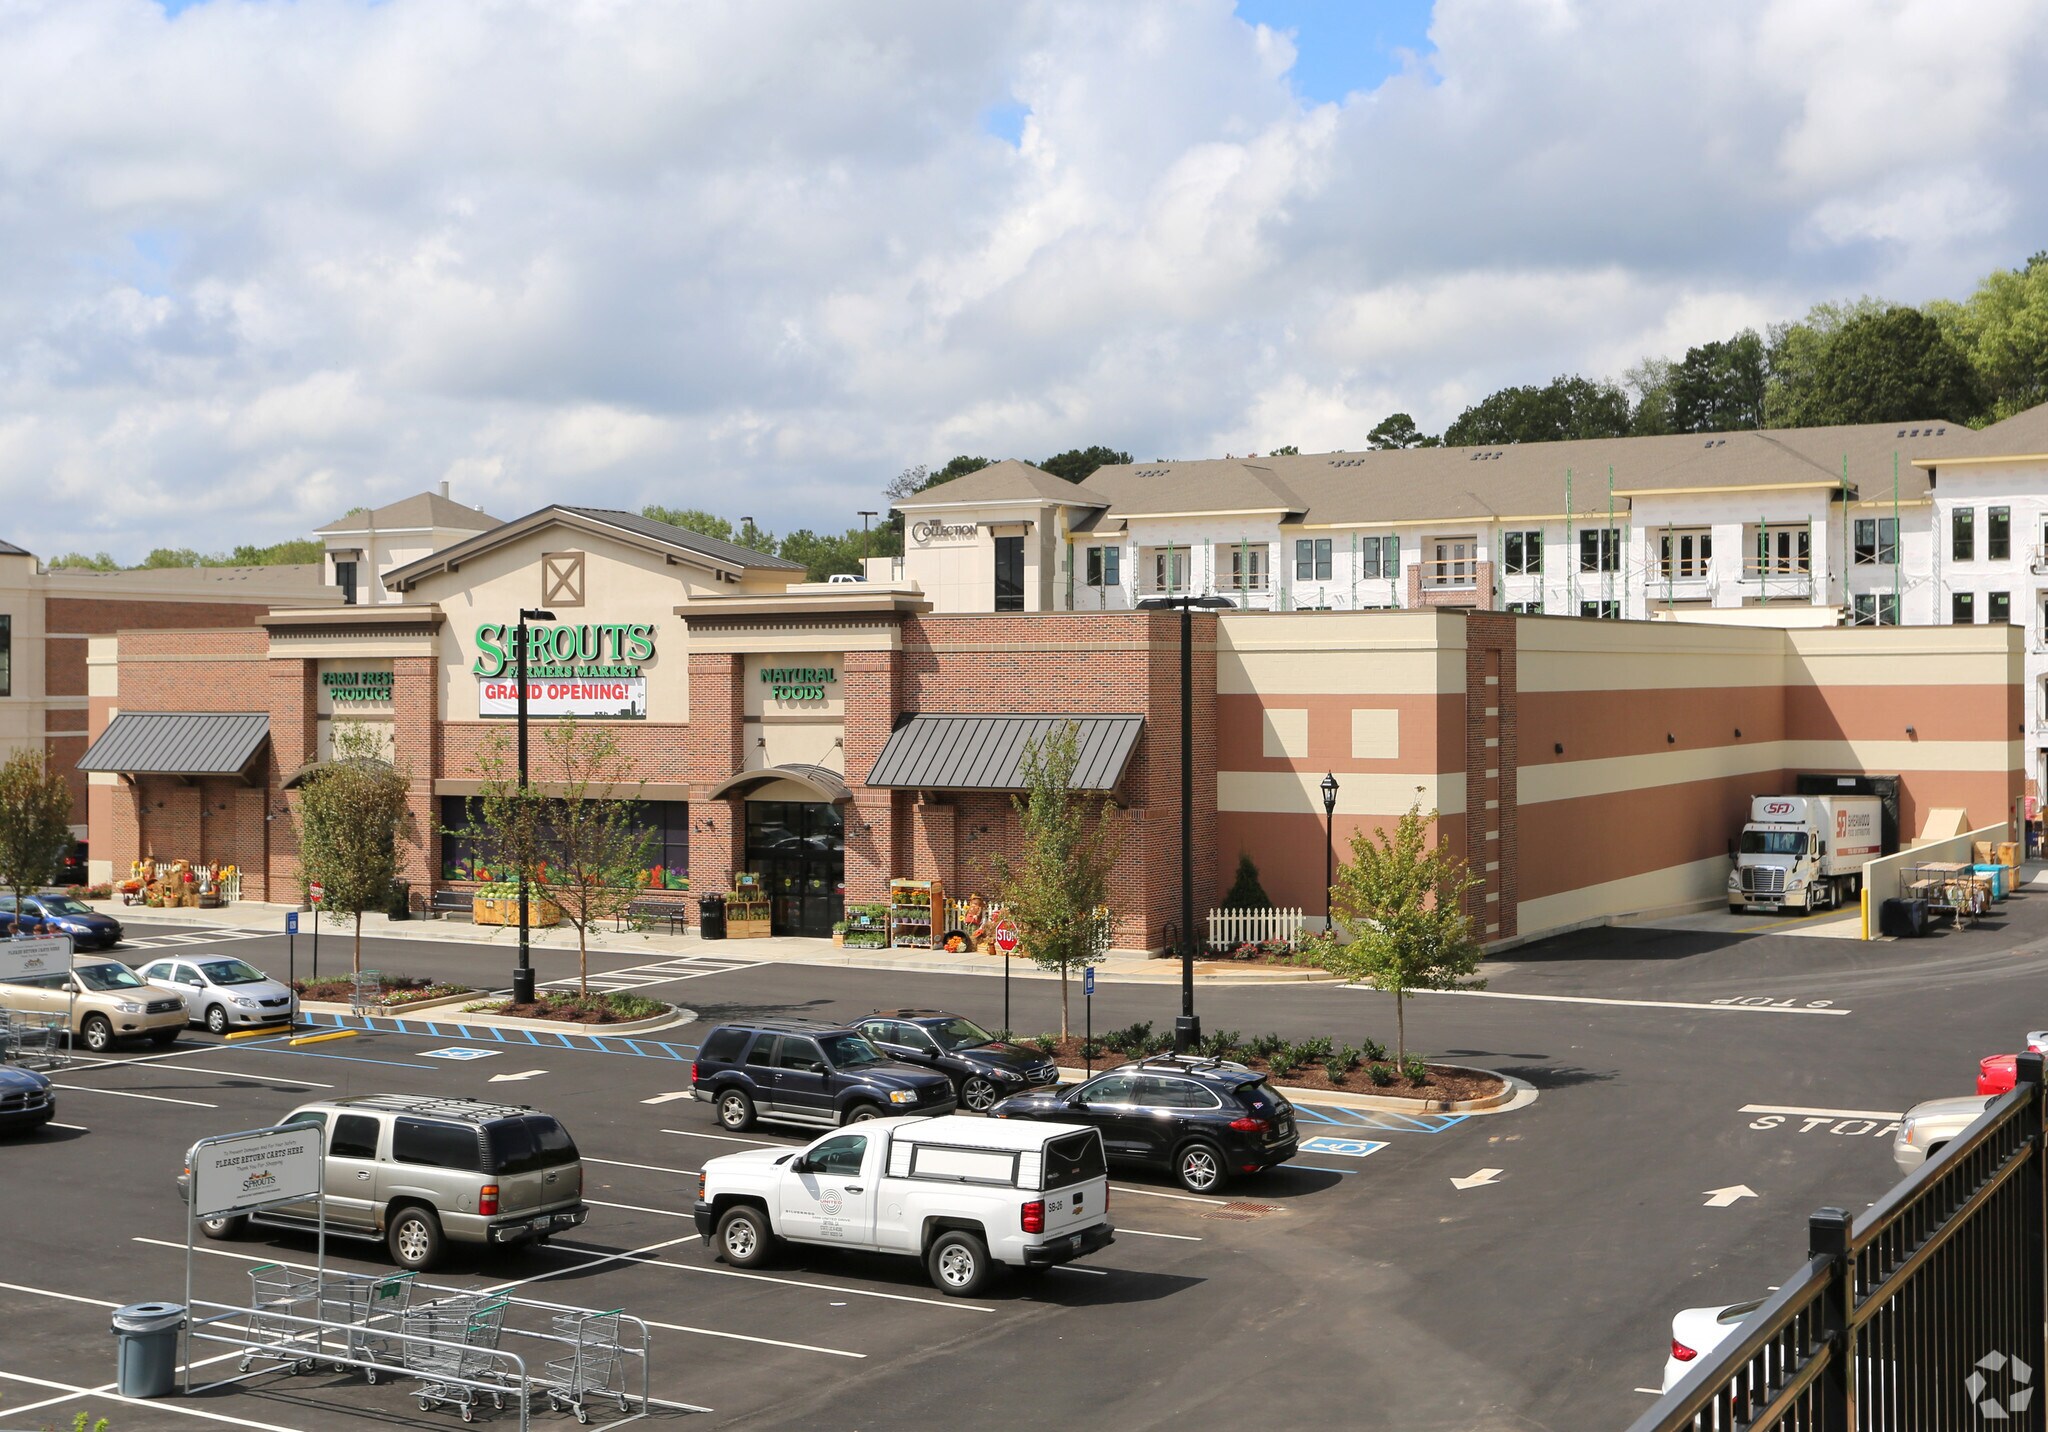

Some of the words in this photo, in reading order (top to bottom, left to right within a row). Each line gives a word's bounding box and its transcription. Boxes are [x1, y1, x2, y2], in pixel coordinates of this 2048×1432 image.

[912, 522, 977, 542] COLLECTION
[322, 672, 358, 686] FARM
[575, 665, 639, 678] MARKET
[760, 668, 837, 683] NATURAL
[330, 687, 392, 701] PRODUCE
[547, 684, 629, 700] OPENING!
[772, 685, 824, 700] FOODS
[1710, 996, 1834, 1008] STOP
[216, 1157, 240, 1168] PLEASE
[241, 1153, 266, 1164] RETURN
[266, 1149, 286, 1159] CARTS
[287, 1146, 304, 1156] HERE
[243, 1176, 276, 1191] SPROUTS
